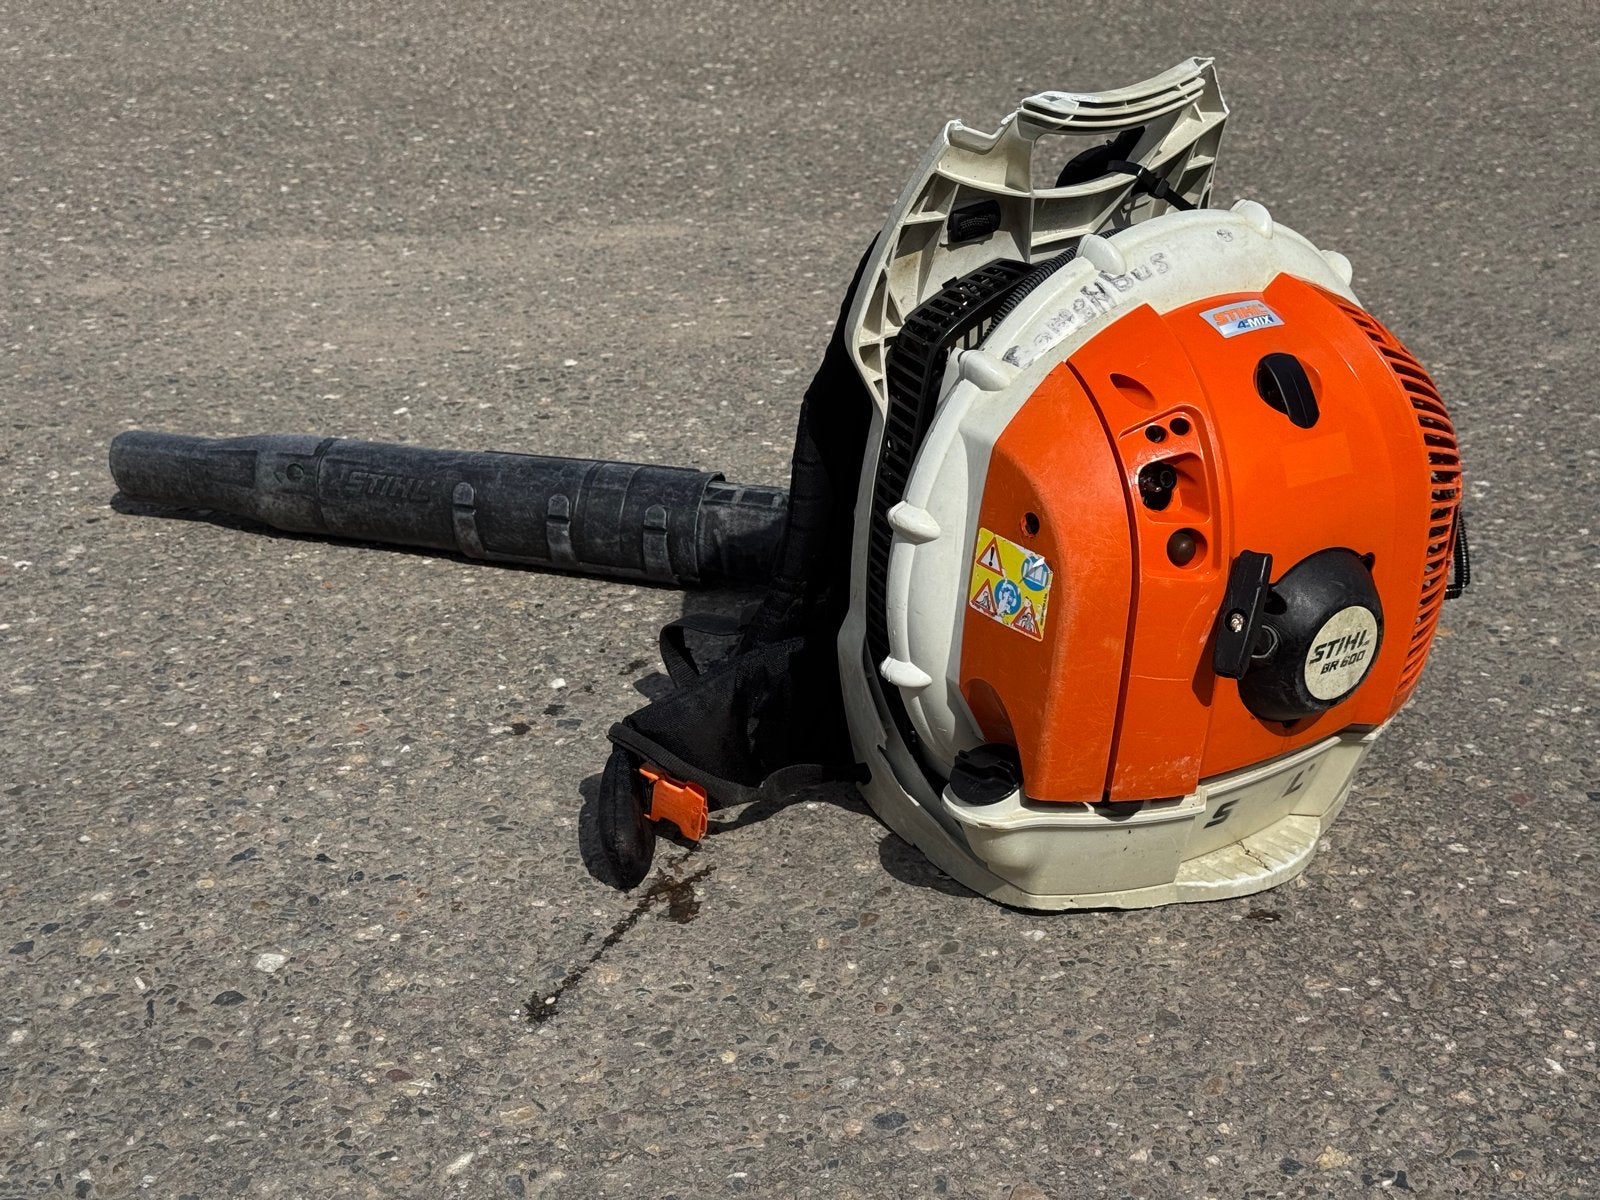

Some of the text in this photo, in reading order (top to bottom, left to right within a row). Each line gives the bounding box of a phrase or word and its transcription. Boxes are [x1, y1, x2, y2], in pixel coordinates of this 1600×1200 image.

[1213, 303, 1268, 326] STIHL
[1237, 314, 1274, 329] 4-MIX
[344, 470, 431, 502] STIHL
[1309, 629, 1369, 665] STIHL
[1320, 650, 1366, 675] BR 600
